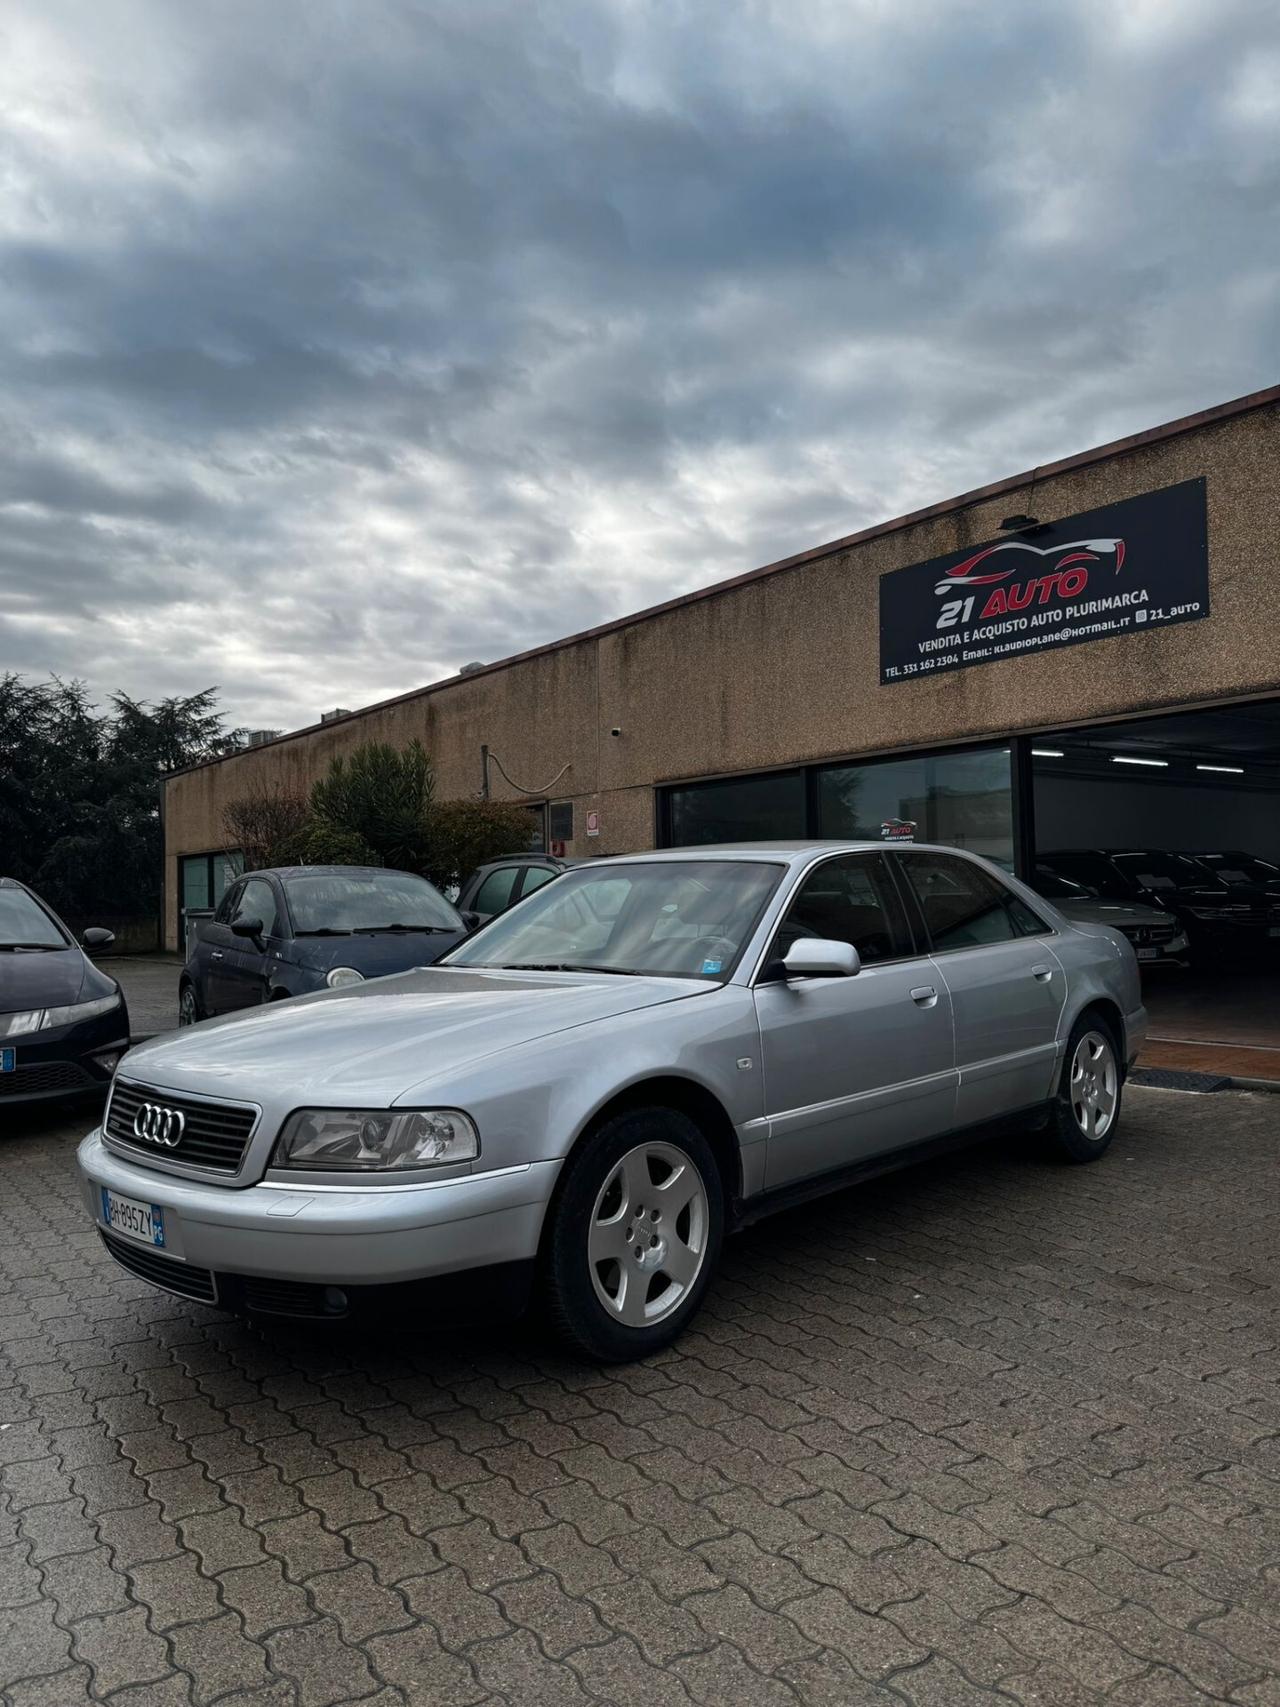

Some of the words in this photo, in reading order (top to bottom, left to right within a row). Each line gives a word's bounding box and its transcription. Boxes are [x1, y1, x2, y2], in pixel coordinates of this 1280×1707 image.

[918, 633, 962, 653] VENDITA
[963, 631, 970, 643] E
[972, 617, 1028, 641] ACQUISTO
[1030, 609, 1063, 628] AUTO
[1065, 589, 1149, 620] PLURIMARCA
[936, 596, 975, 629] 21
[979, 567, 1088, 619] AUTO
[885, 666, 902, 678] TEL.
[903, 663, 918, 675] 331
[919, 659, 935, 671] 162
[936, 653, 959, 667] 2304
